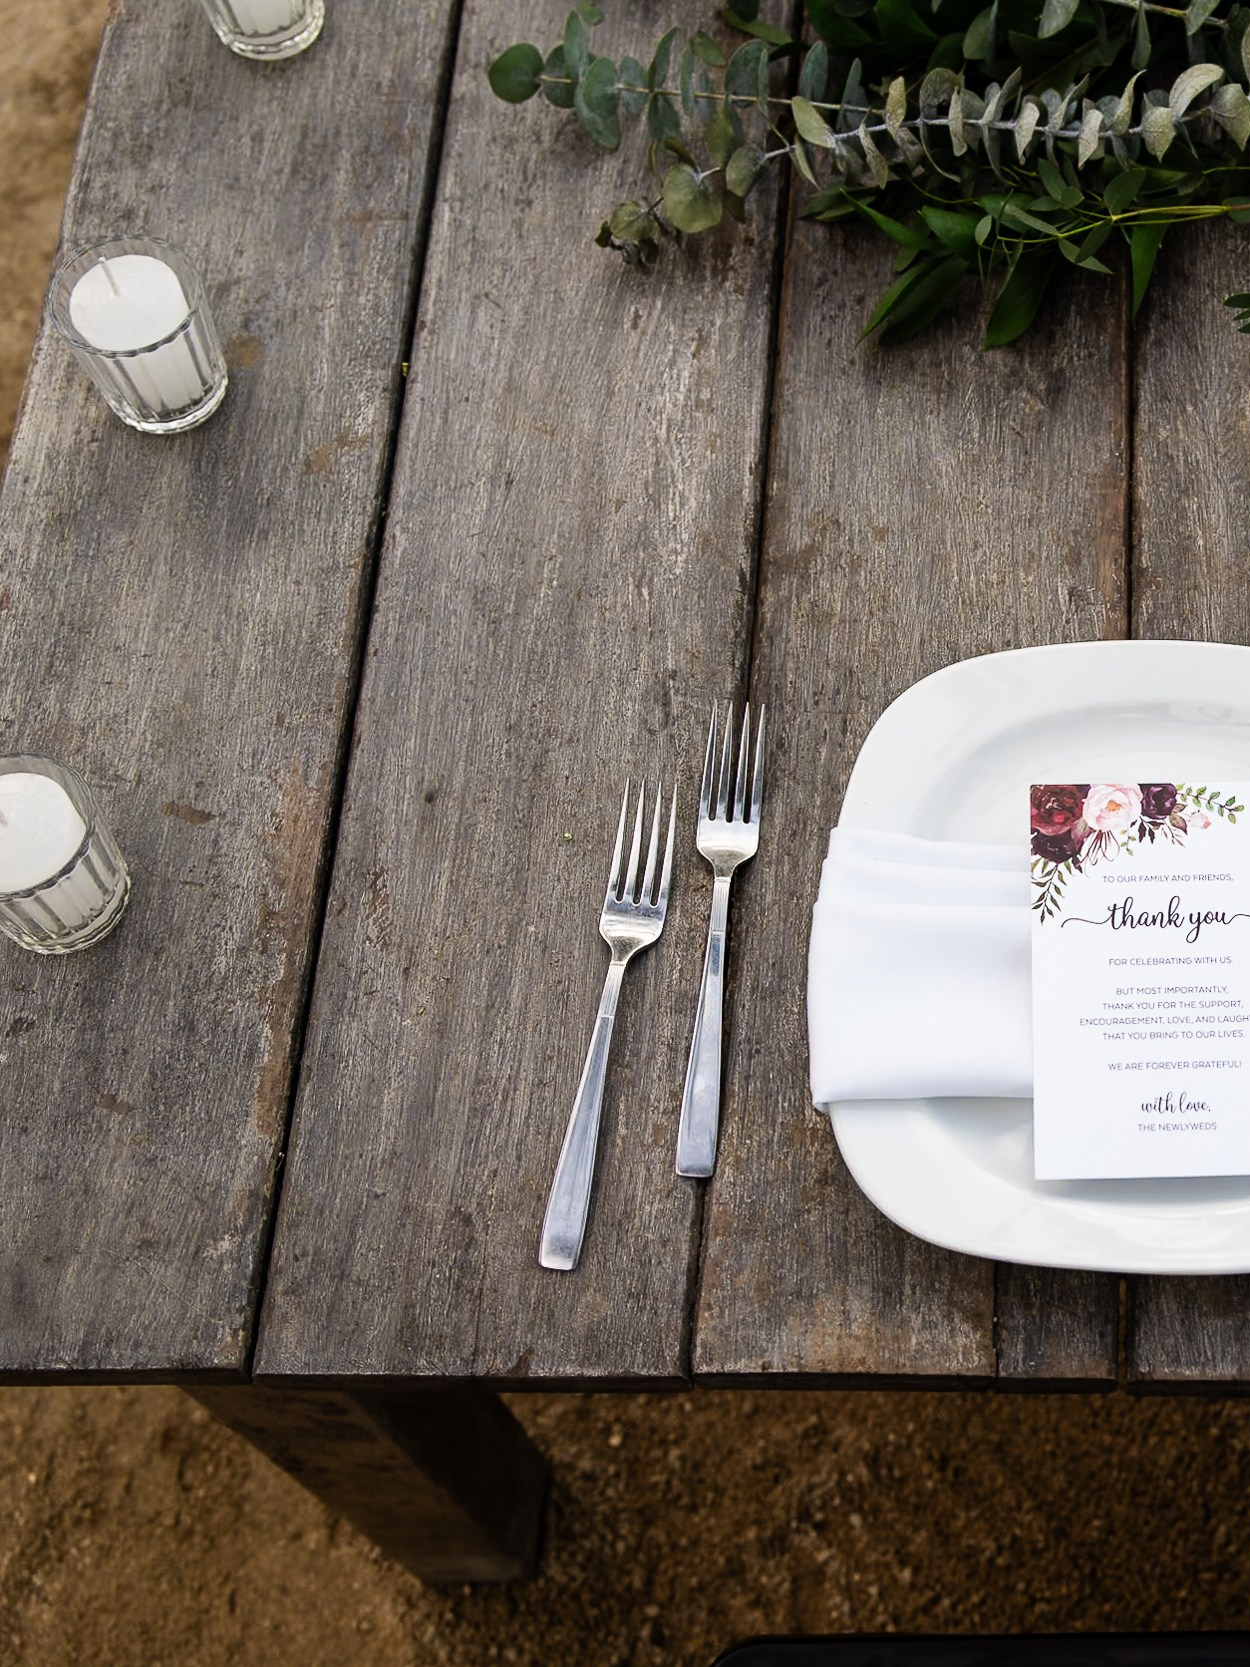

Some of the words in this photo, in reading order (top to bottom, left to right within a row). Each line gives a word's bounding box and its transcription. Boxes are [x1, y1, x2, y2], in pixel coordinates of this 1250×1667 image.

[1102, 875, 1116, 884] TO
[1116, 875, 1137, 883] OUR
[1138, 874, 1170, 883] FAMILY
[1171, 874, 1191, 882] AND
[1192, 873, 1234, 882] FRIENDS,
[1061, 895, 1185, 930] thank
[1108, 958, 1127, 966] FOR
[1129, 957, 1193, 966] CELEBRATING
[1193, 956, 1217, 965] WITH
[1115, 987, 1134, 996] BUT
[1136, 987, 1162, 995] MOST
[1164, 985, 1229, 995] IMPORTANTLY,
[1102, 1002, 1134, 1011] THANK
[1135, 1002, 1155, 1010] YOU
[1157, 1001, 1177, 1009] FOR
[1178, 1001, 1197, 1009] THE
[1198, 1000, 1244, 1009] SUPPORT,
[1079, 1016, 1165, 1026] ENCOURAGEMENT,
[1167, 1015, 1194, 1025] LOVE,
[1195, 1015, 1216, 1023] AND
[1102, 1032, 1125, 1040] THAT
[1127, 1031, 1147, 1040] YOU
[1149, 1031, 1179, 1040] BRING
[1181, 1031, 1194, 1039] TO
[1195, 1030, 1216, 1039] OUR
[1108, 1062, 1123, 1071] WE
[1124, 1062, 1144, 1071] ARE
[1145, 1060, 1190, 1070] FOREVER
[1191, 1060, 1242, 1069] GRATEFUL!
[1141, 1091, 1176, 1114] with
[1137, 1123, 1156, 1132] THE
[1158, 1122, 1217, 1132] NEWLYWEDS
